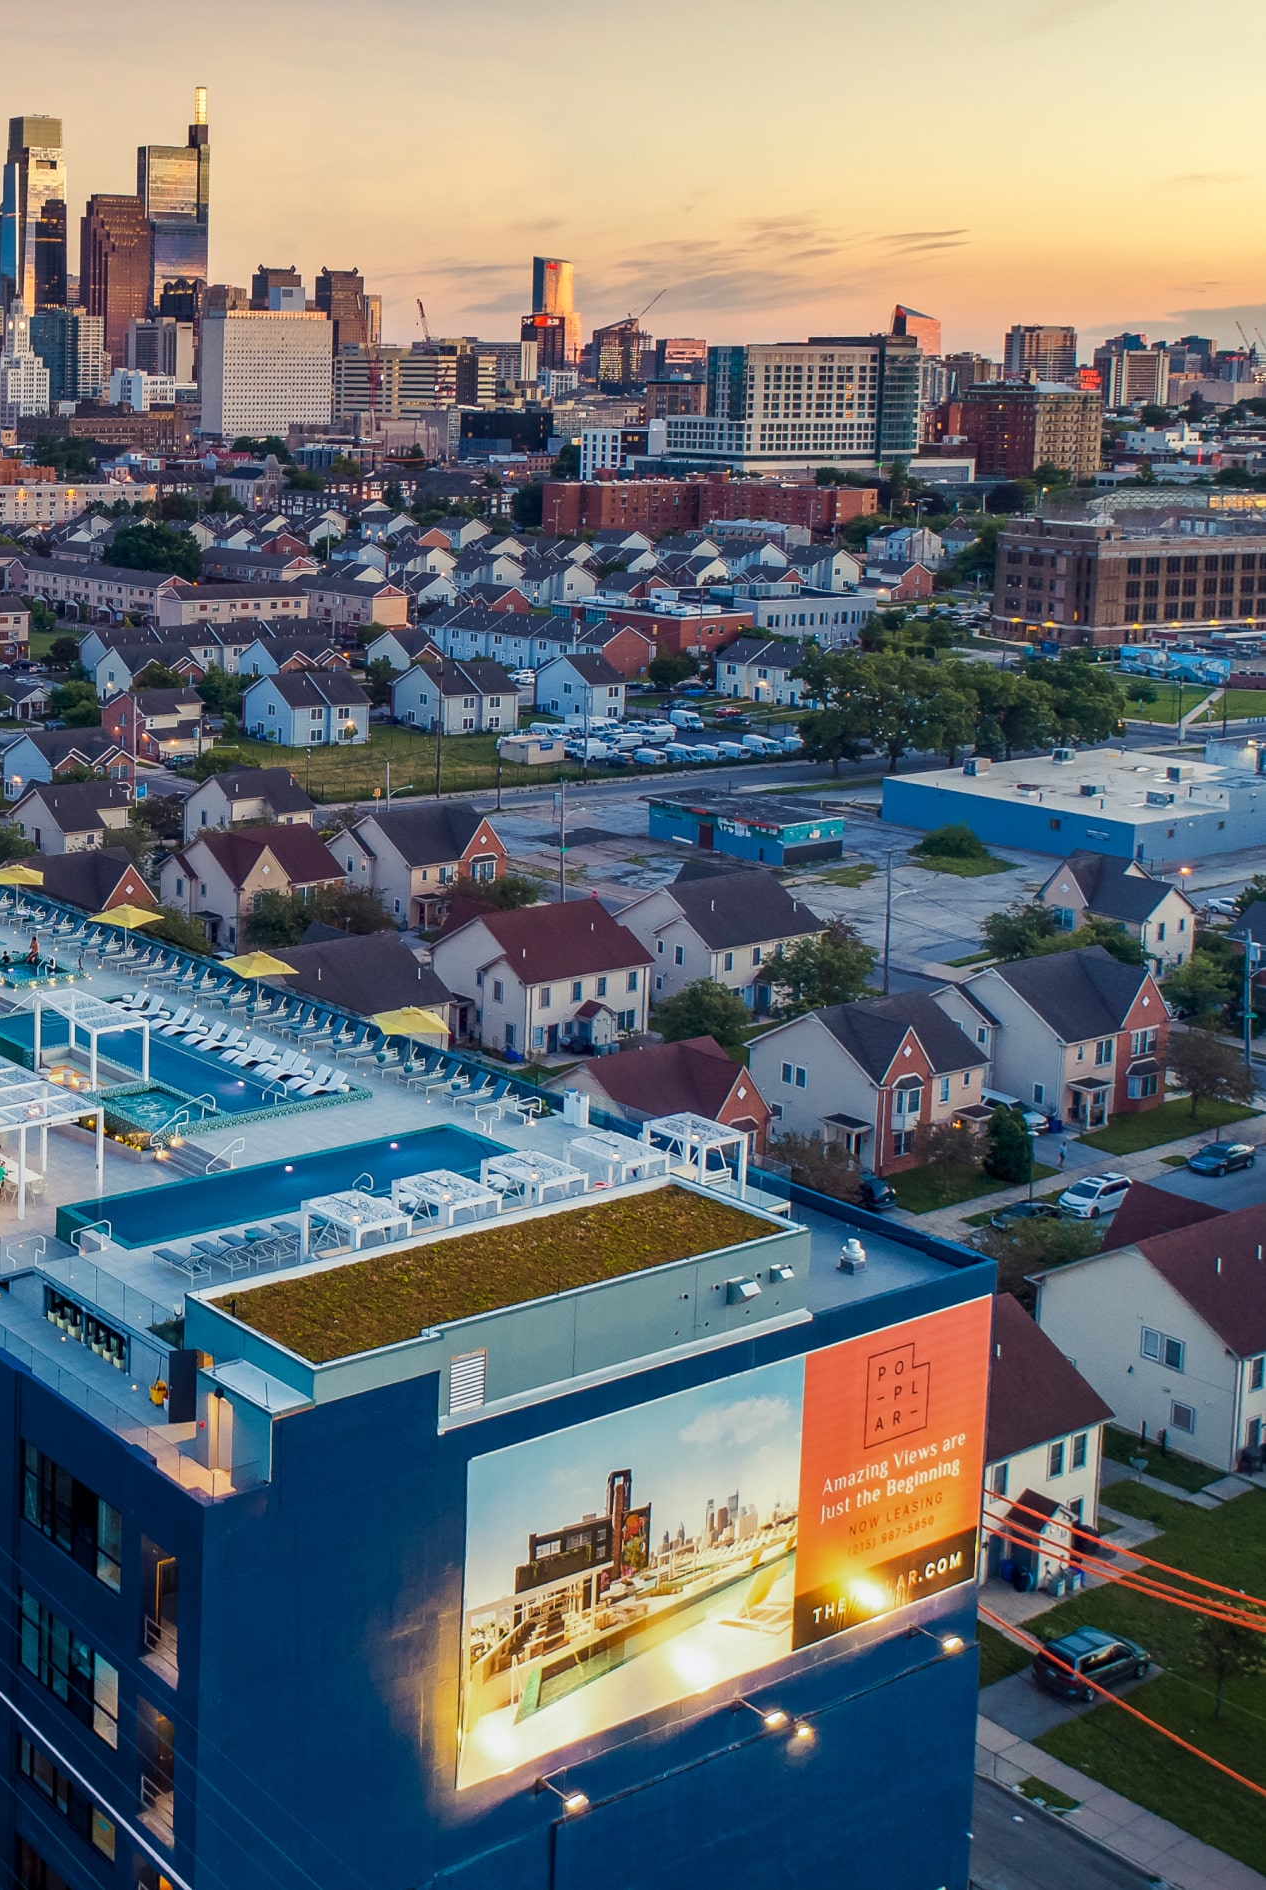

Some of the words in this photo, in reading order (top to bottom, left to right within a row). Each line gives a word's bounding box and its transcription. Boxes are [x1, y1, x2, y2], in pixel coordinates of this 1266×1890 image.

[820, 1497, 851, 1525] Just
[856, 1488, 881, 1509] the
[886, 1458, 960, 1497] Beginning
[821, 1460, 889, 1497] Amazing
[893, 1442, 938, 1469] Views
[942, 1432, 966, 1452] are
[849, 1514, 880, 1537] NOW
[886, 1491, 944, 1523] LEASING
[847, 1536, 877, 1559] (215)
[812, 1550, 963, 1624] THEAR.COM
